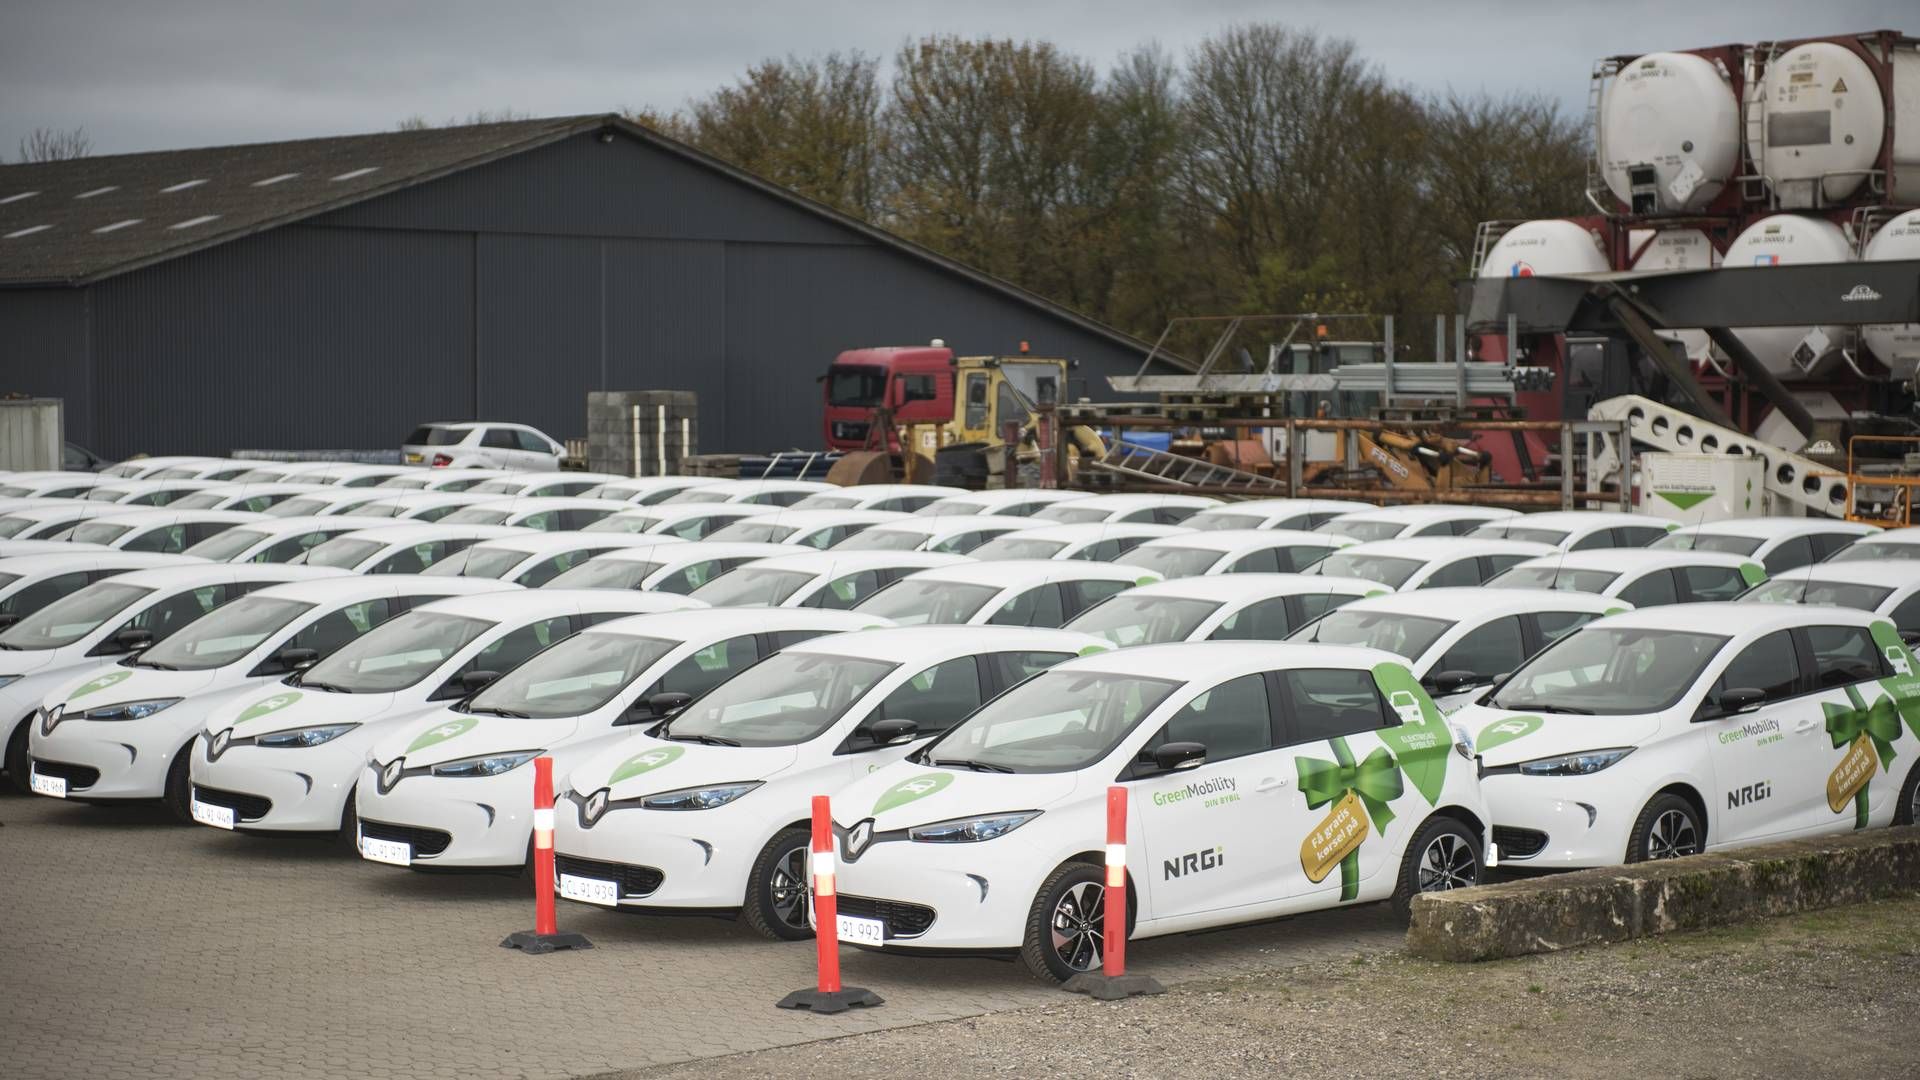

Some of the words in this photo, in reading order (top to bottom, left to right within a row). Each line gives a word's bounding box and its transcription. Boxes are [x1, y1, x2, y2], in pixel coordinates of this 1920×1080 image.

[1718, 718, 1780, 745] GreenMobility
[1845, 747, 1864, 774] gratis
[1153, 777, 1236, 806] GreenMobility
[1205, 798, 1218, 809] DIN
[1220, 793, 1241, 806] BYBIL
[1727, 779, 1771, 810] NRGi
[1312, 832, 1324, 849] Få
[1325, 807, 1350, 839] gratis
[1346, 817, 1358, 837] på
[379, 845, 388, 858] 91
[1163, 846, 1224, 881] NRGi
[567, 880, 577, 895] CL
[581, 882, 591, 897] 91
[595, 885, 614, 900] 939
[842, 920, 853, 937] 91
[858, 923, 880, 941] 992
